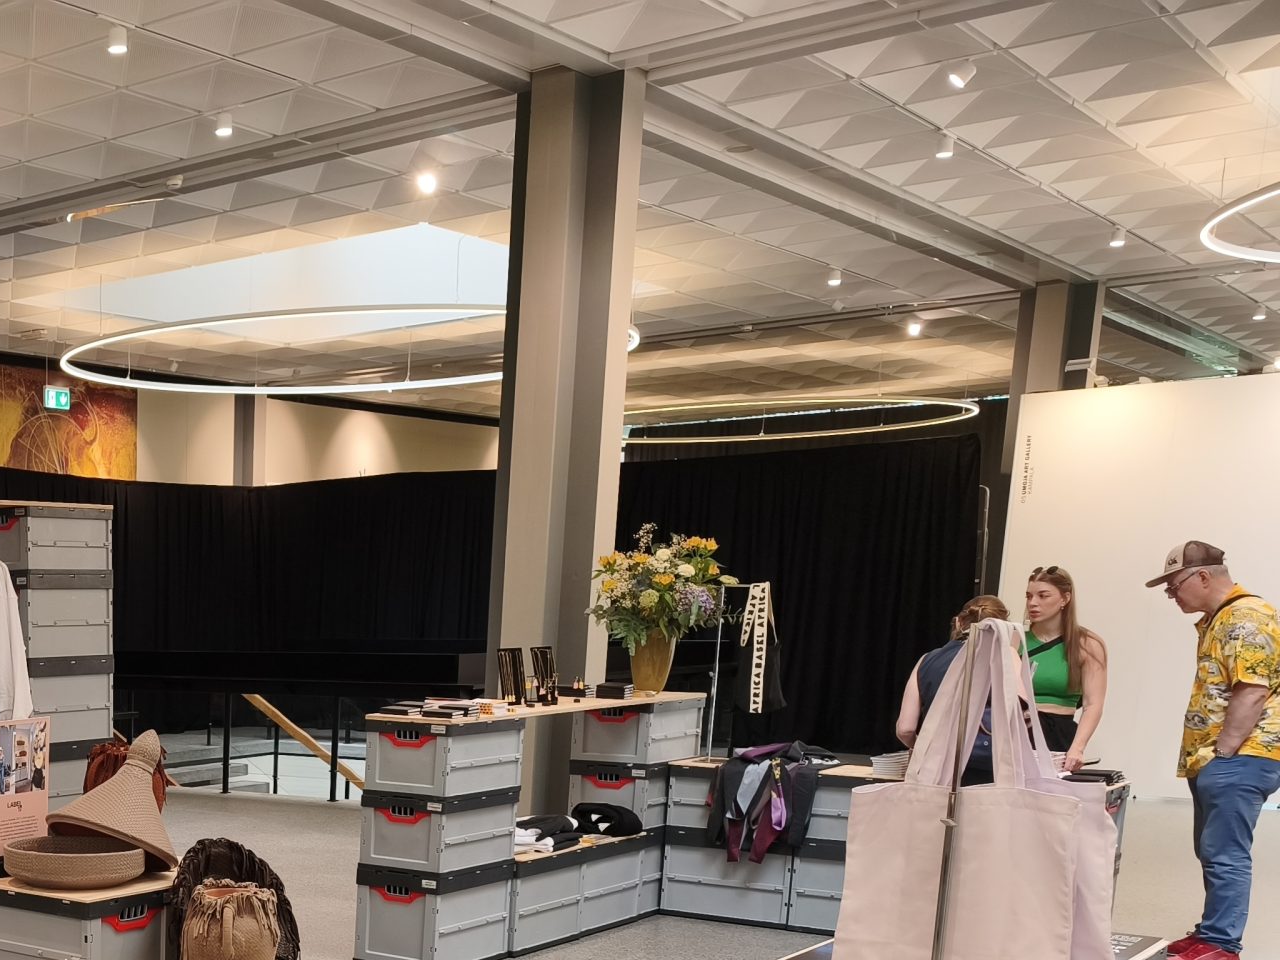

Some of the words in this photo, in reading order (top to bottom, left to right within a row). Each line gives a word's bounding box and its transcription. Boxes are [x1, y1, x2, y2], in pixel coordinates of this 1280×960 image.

[757, 587, 766, 628] AFRICA
[754, 632, 765, 669] BASEL
[752, 672, 762, 713] AFRICA
